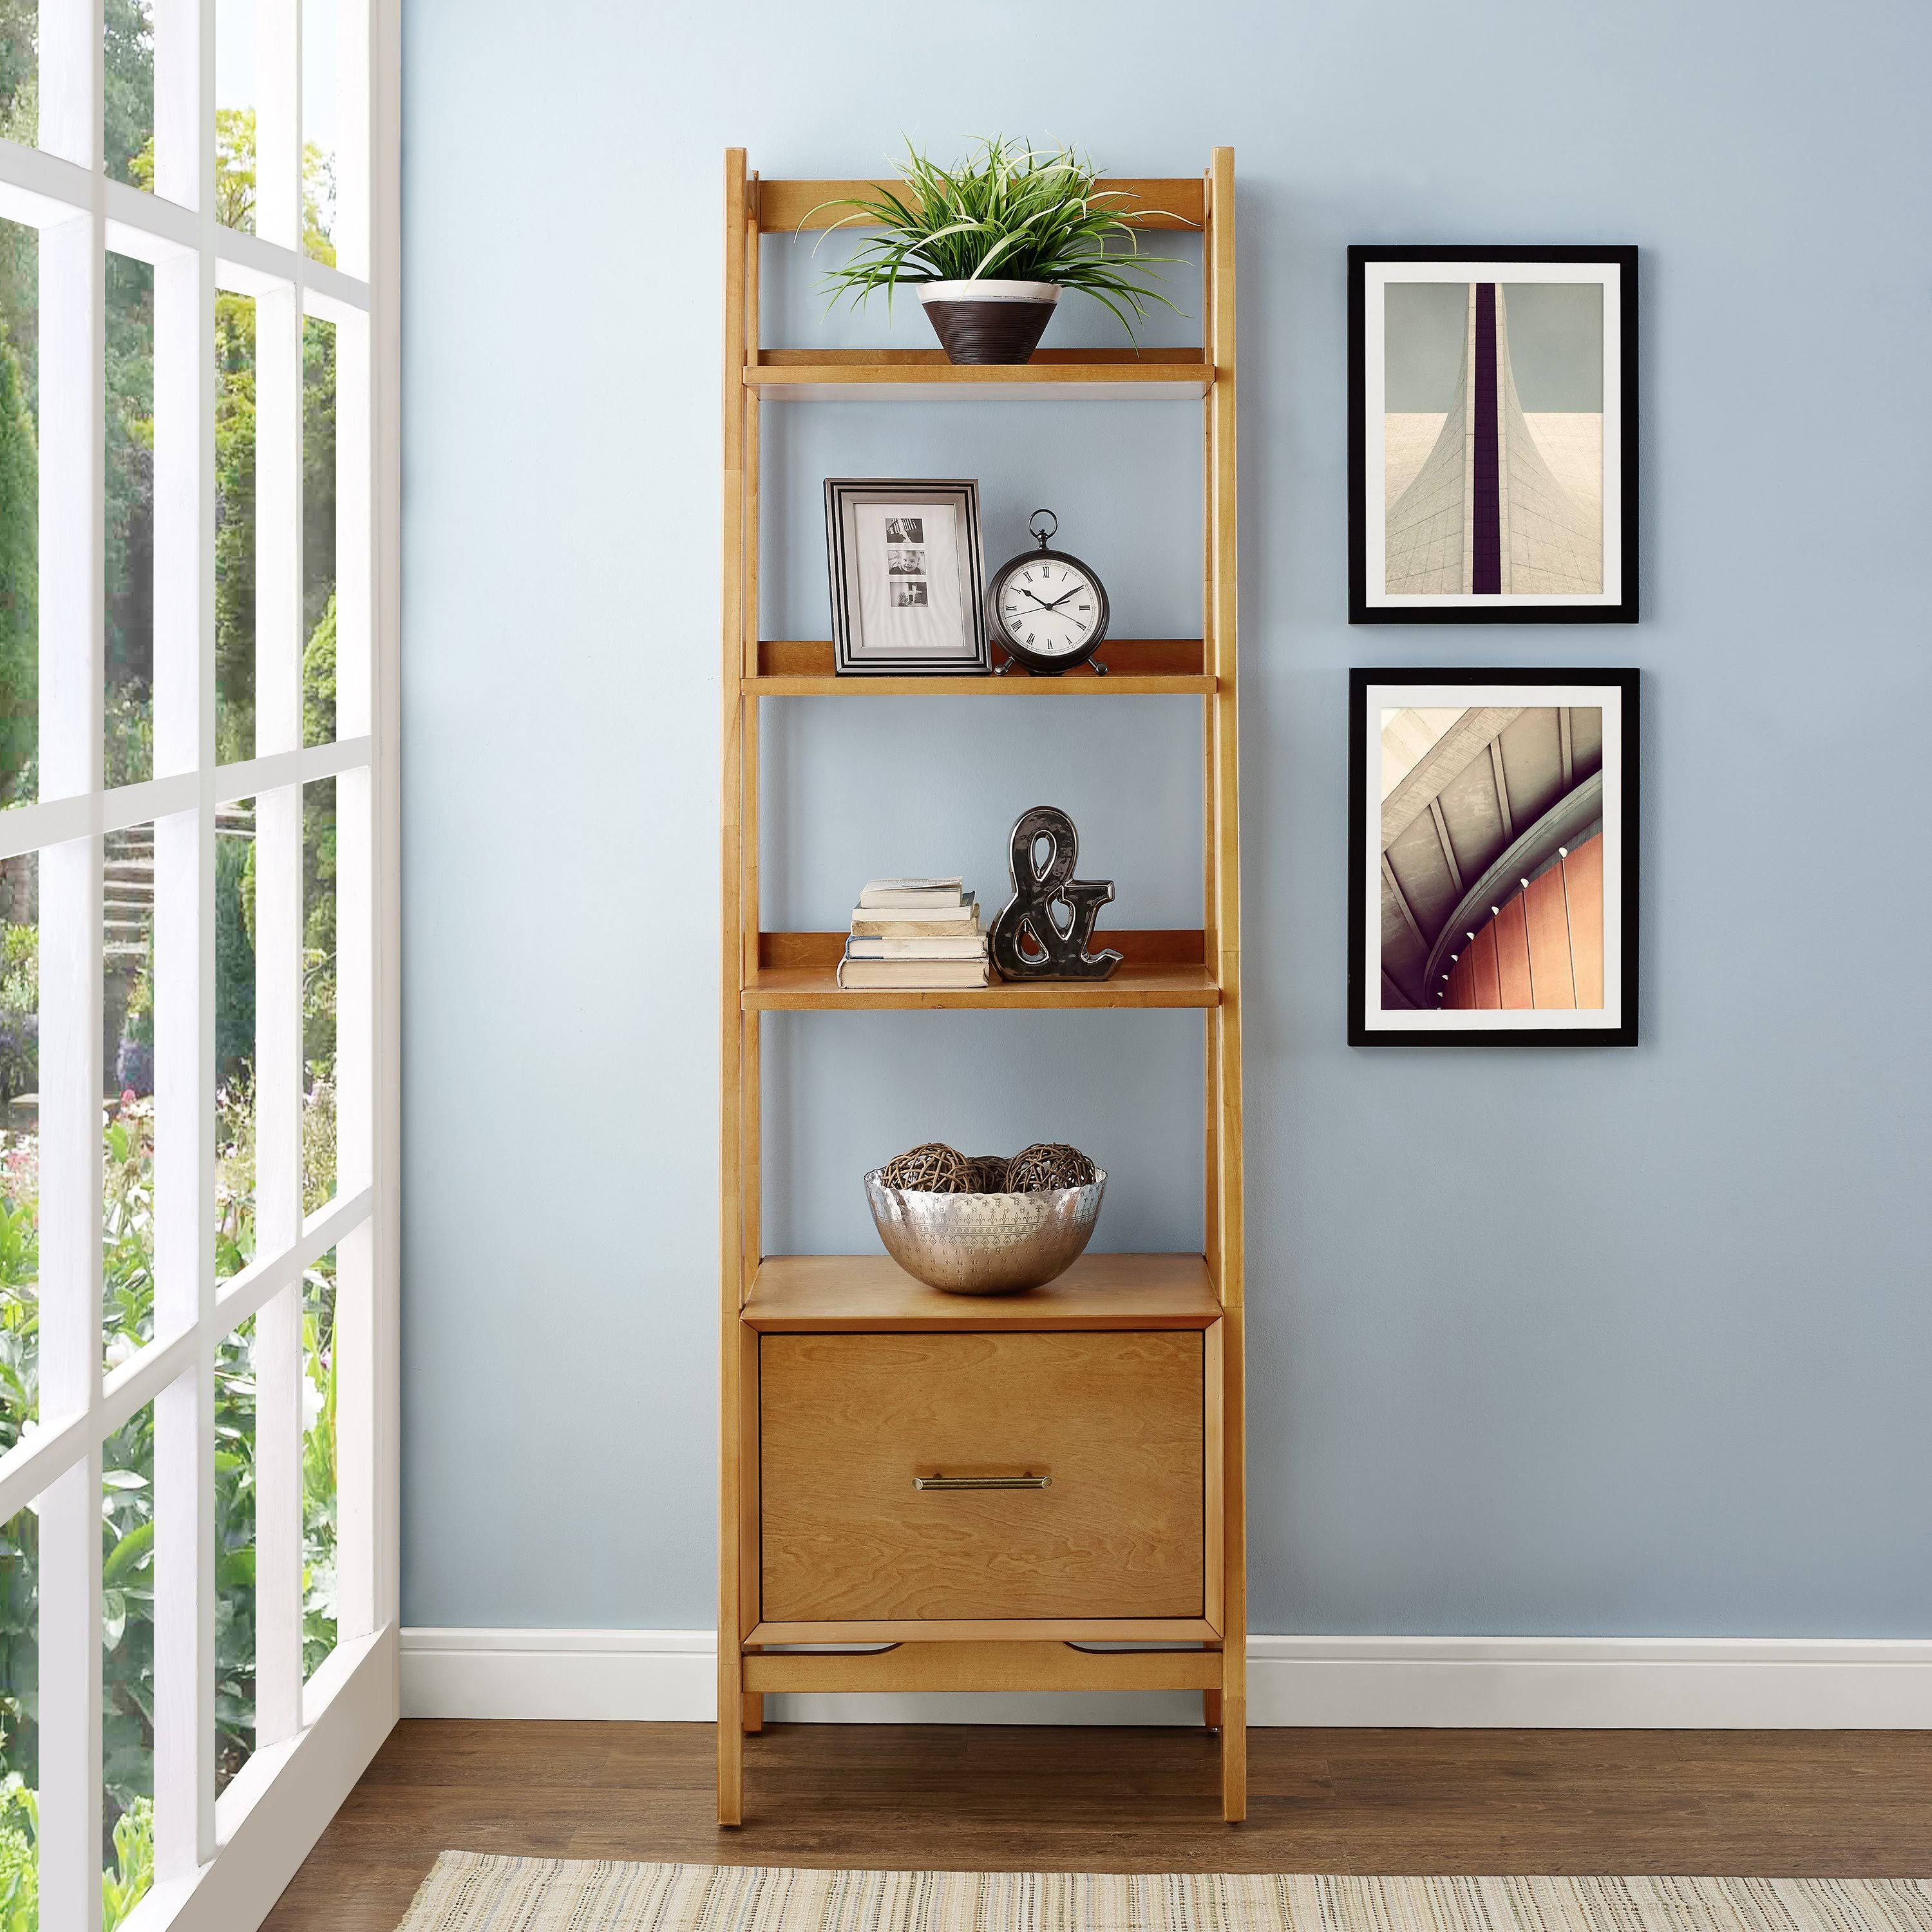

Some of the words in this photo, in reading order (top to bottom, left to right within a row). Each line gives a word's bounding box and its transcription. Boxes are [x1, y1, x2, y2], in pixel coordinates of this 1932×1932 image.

[1023, 571, 1033, 583] XI
[1061, 571, 1068, 582] I
[1010, 585, 1021, 594] X
[1010, 620, 1023, 632] VIII
[1076, 621, 1087, 631] IV
[1026, 632, 1036, 645] VII
[1047, 638, 1053, 649] VI
[1065, 634, 1072, 645] V
[991, 806, 1124, 982] &
